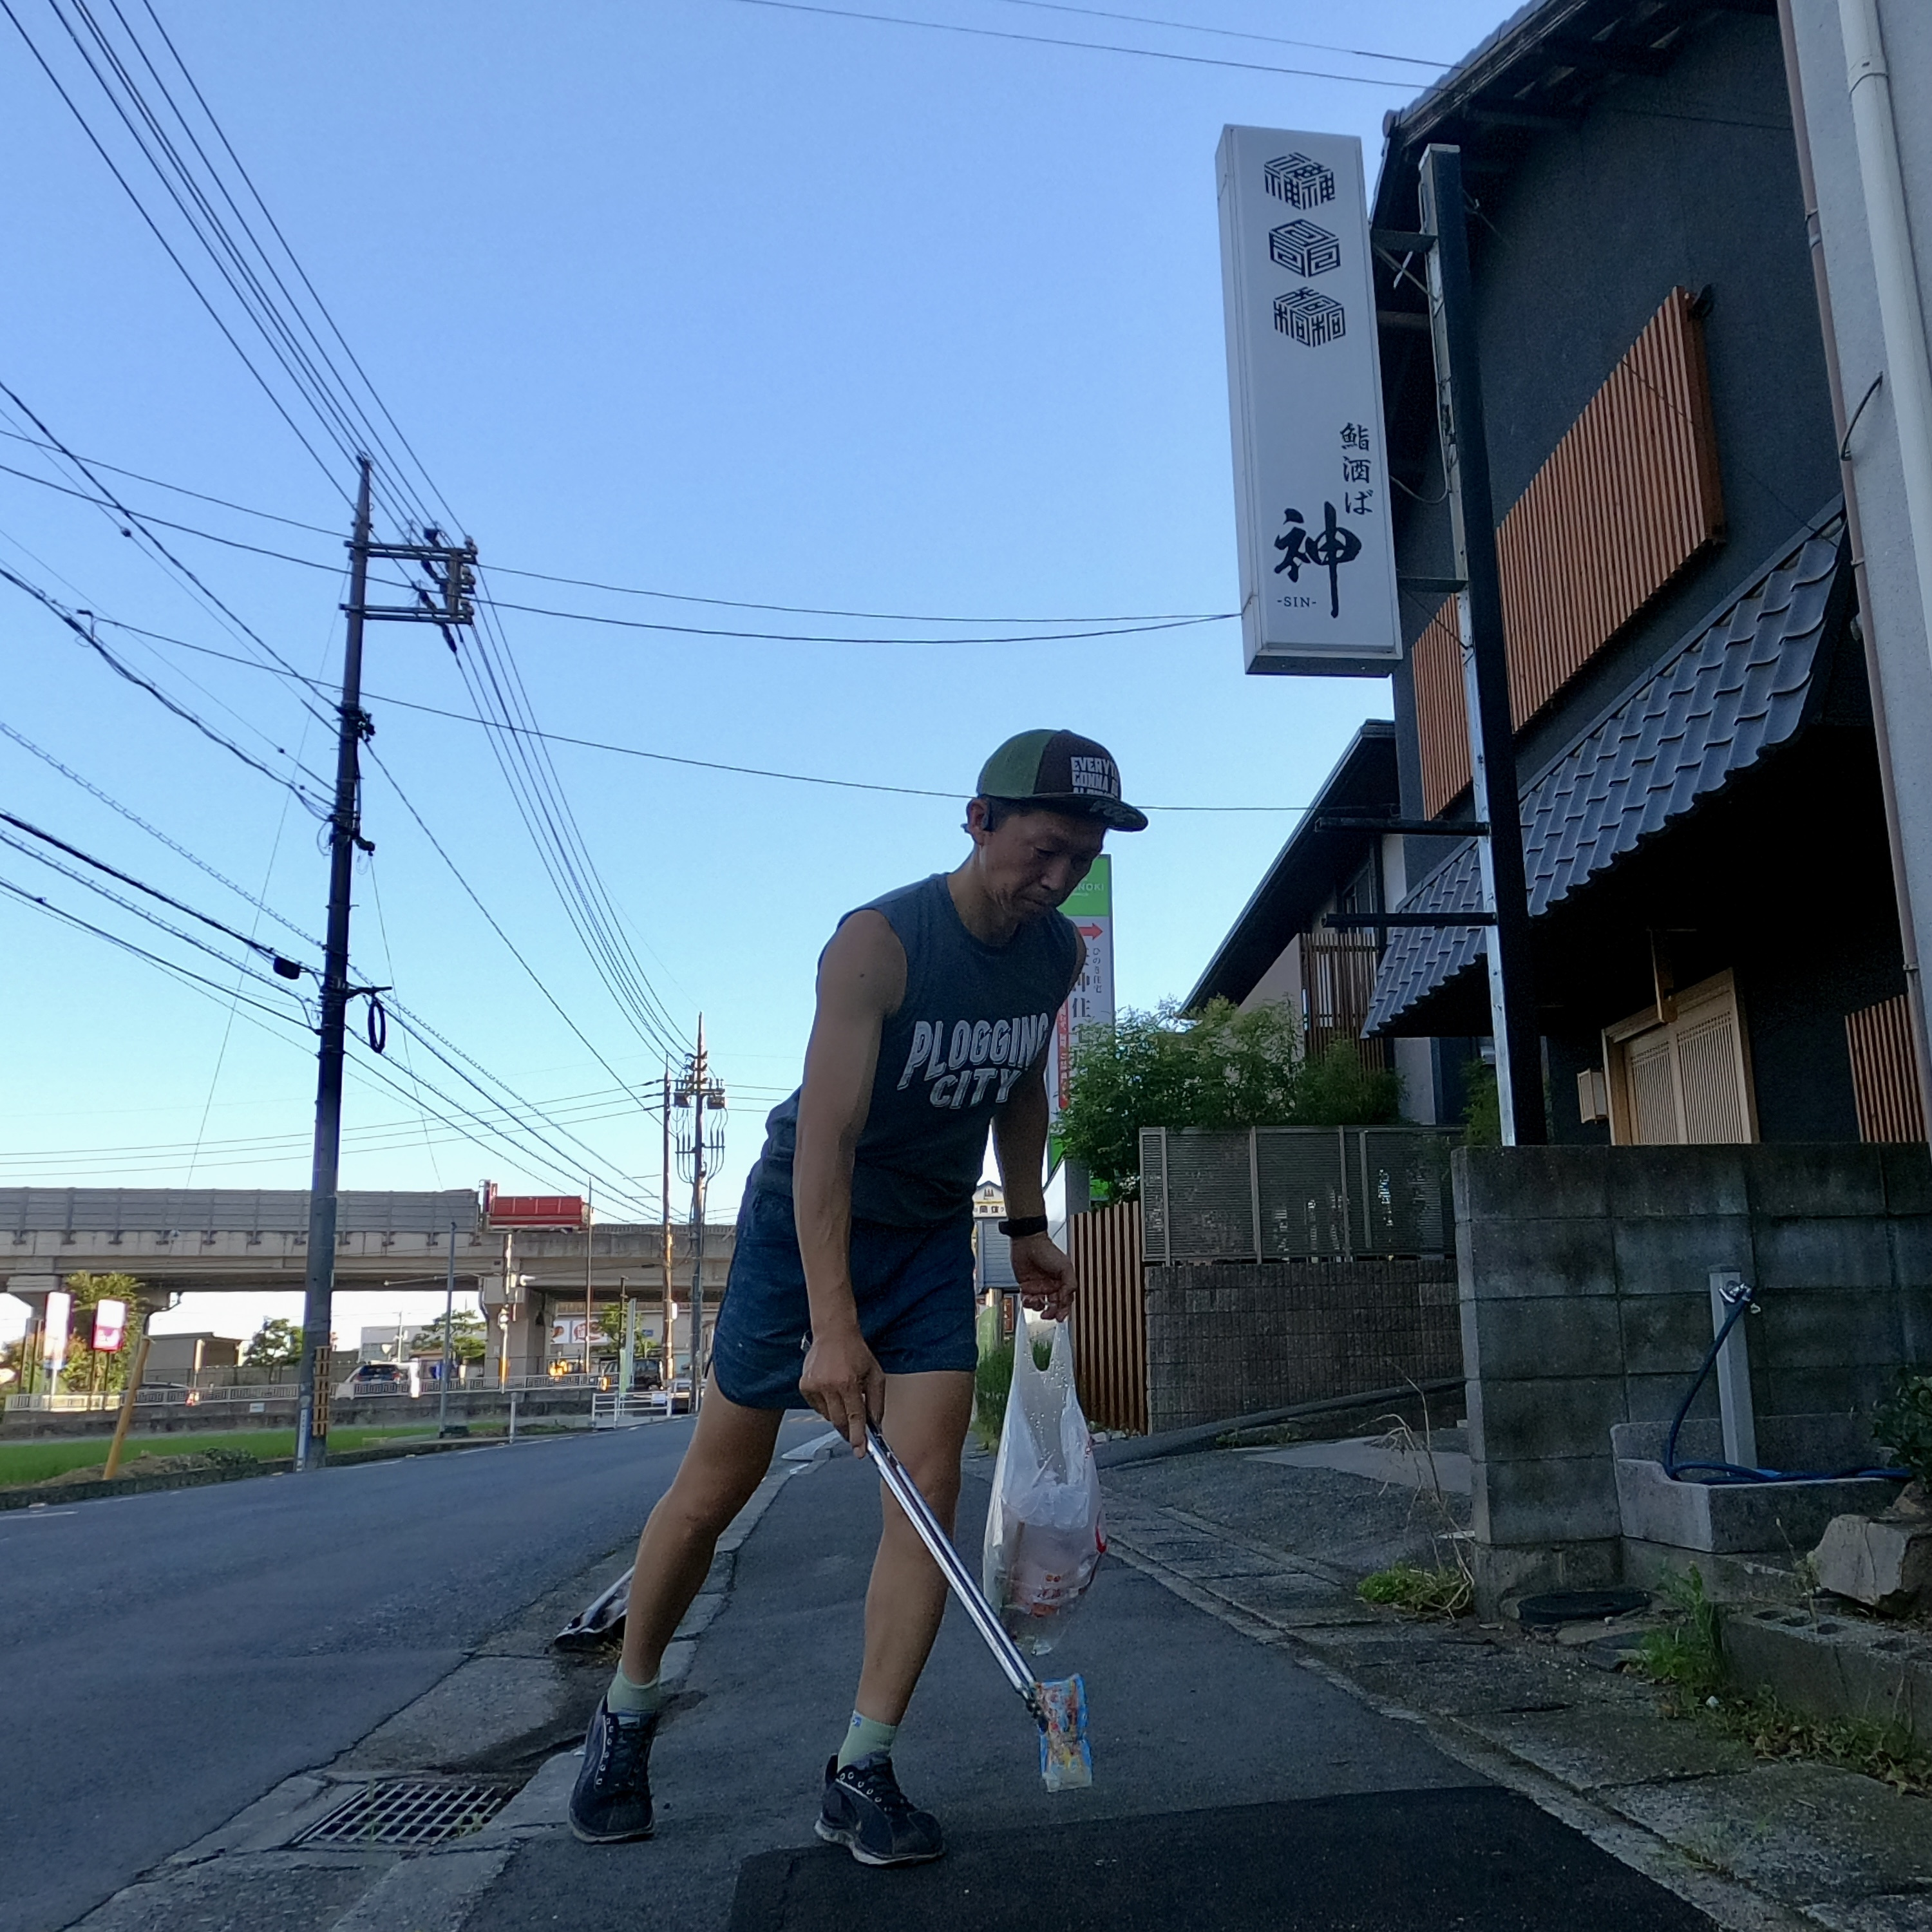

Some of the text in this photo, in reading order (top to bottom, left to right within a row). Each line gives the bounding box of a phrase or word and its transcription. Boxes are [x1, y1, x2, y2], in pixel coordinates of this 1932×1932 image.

[1340, 422, 1373, 515] 鮨酒ば
[1274, 501, 1361, 618] 神
[1072, 772, 1108, 792] GONNA
[896, 1012, 1048, 1090] PLOGGING
[930, 1068, 1022, 1109] CITY
